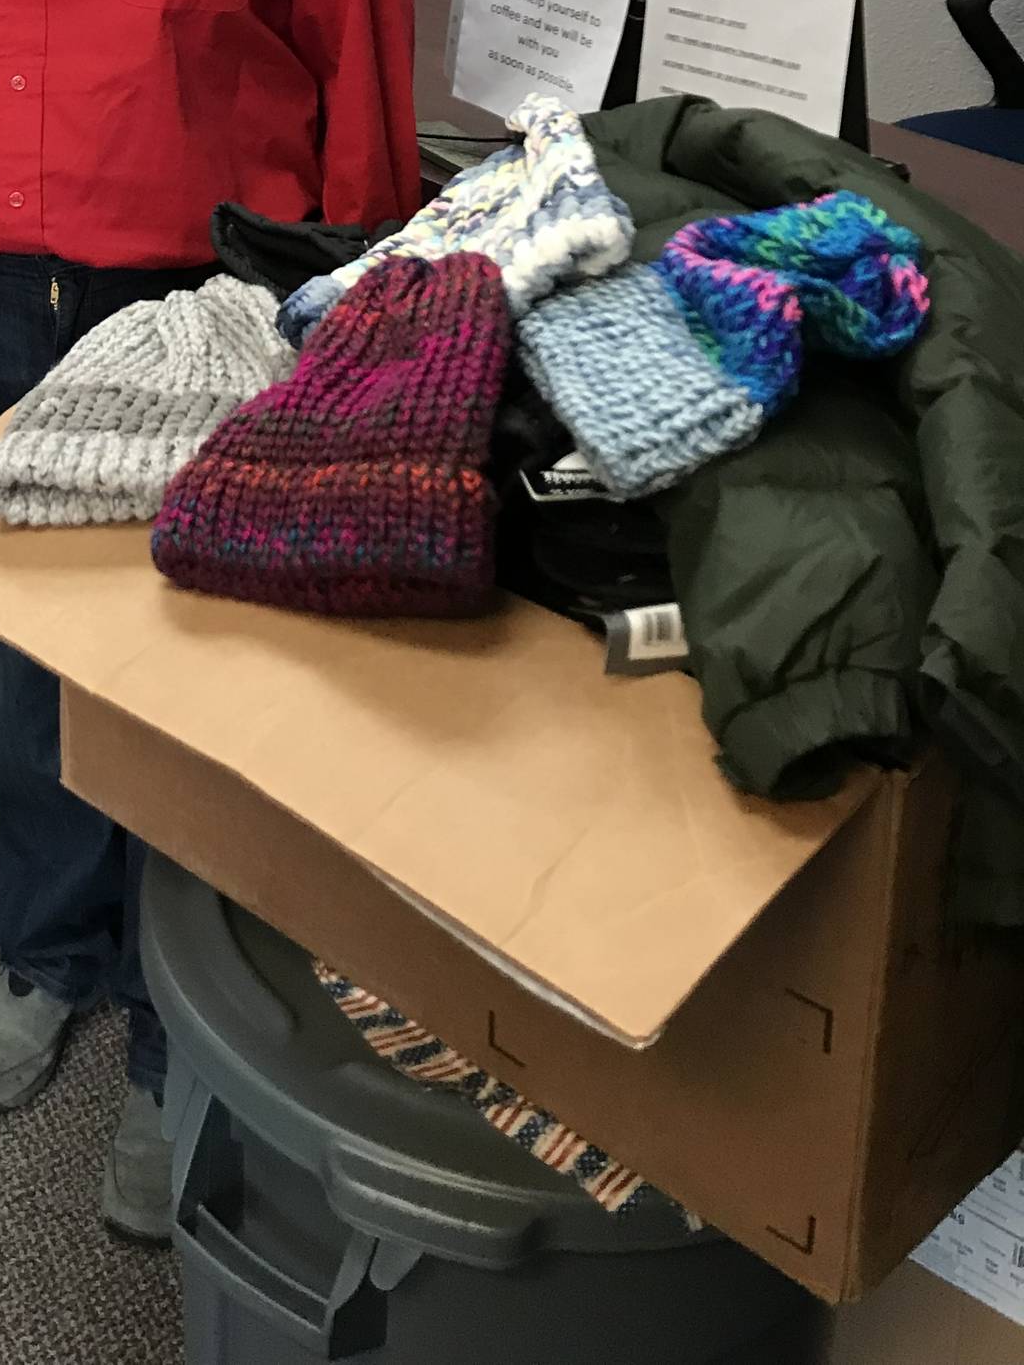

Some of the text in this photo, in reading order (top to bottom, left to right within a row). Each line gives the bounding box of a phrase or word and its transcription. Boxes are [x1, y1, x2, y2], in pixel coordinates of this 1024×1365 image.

[490, 3, 593, 48] coffee and we will be
[547, 1, 590, 23] yourself
[589, 14, 602, 27] to
[517, 34, 560, 59] with you
[487, 48, 499, 61] as
[500, 54, 525, 70] soon
[525, 64, 537, 76] as
